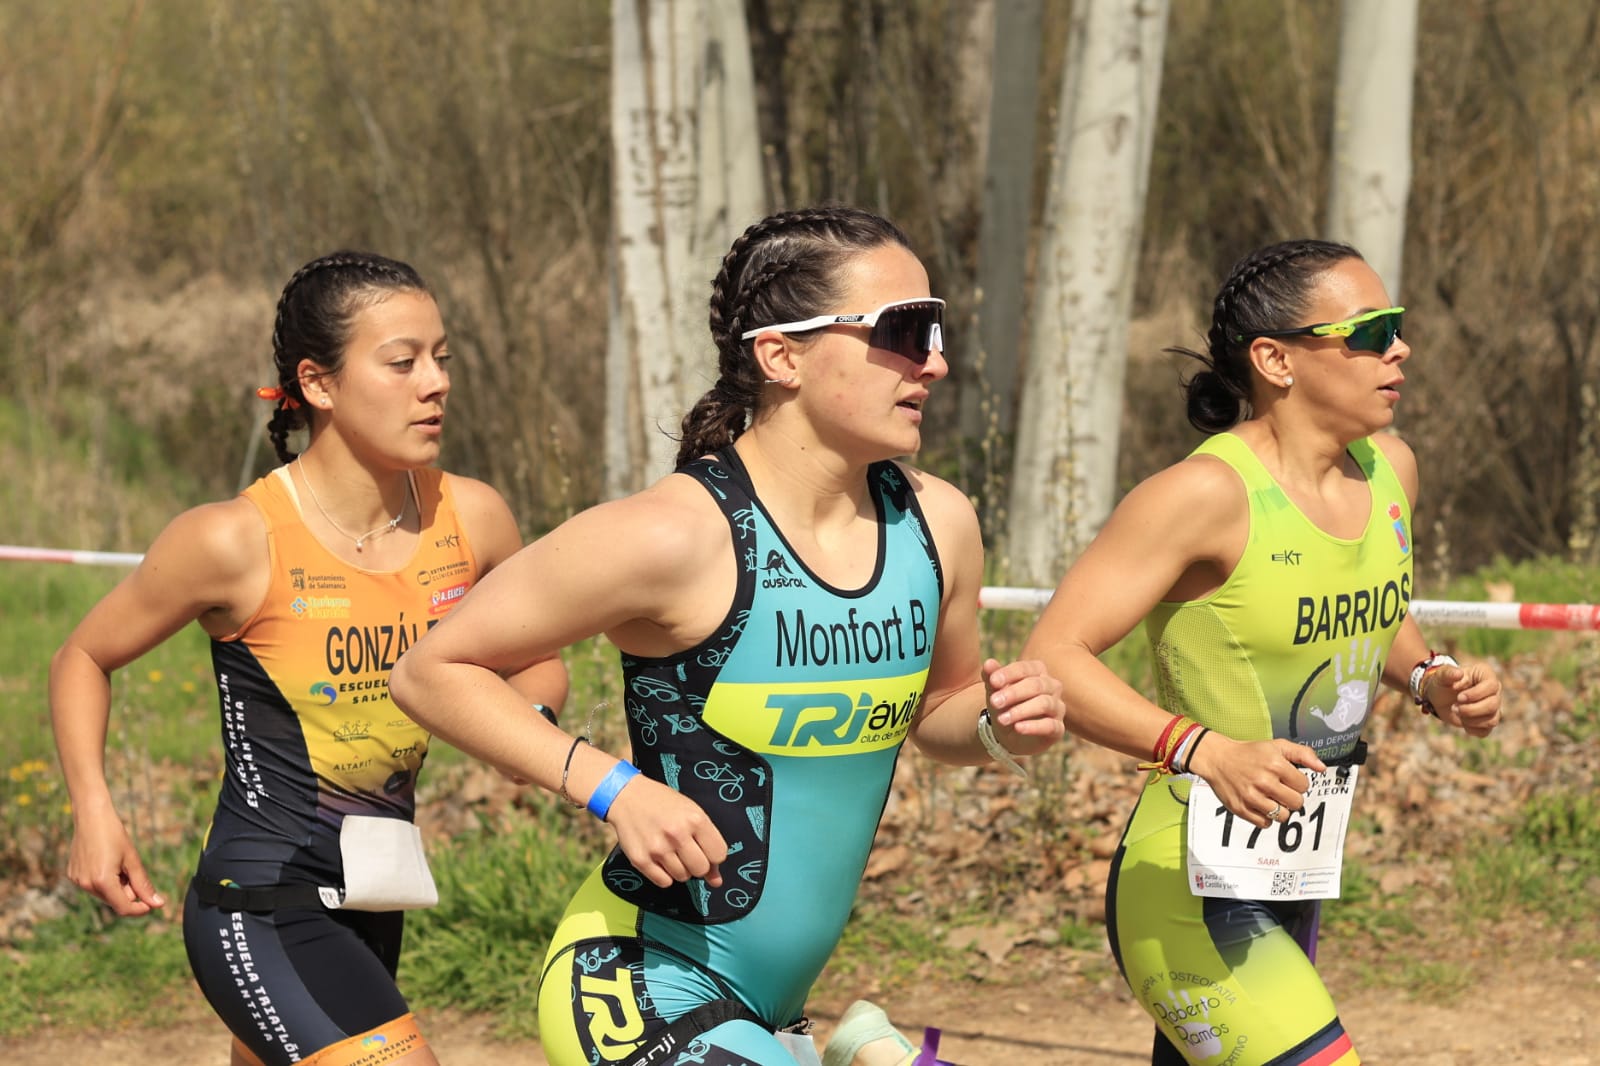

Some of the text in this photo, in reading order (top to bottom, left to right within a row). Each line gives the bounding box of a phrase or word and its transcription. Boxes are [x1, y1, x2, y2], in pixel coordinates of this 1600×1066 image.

[762, 576, 807, 589] austral
[1293, 572, 1410, 645] BARRIOS
[326, 612, 439, 676] GONZÁ
[776, 599, 931, 667] Monfort B.
[1257, 856, 1280, 865] SARA
[219, 928, 273, 1042] SALMANTINA
[231, 912, 302, 1063] ESCUELA TRIATLÓN
[1153, 997, 1220, 1027] Roberto
[1174, 1023, 1229, 1047] Ramos
